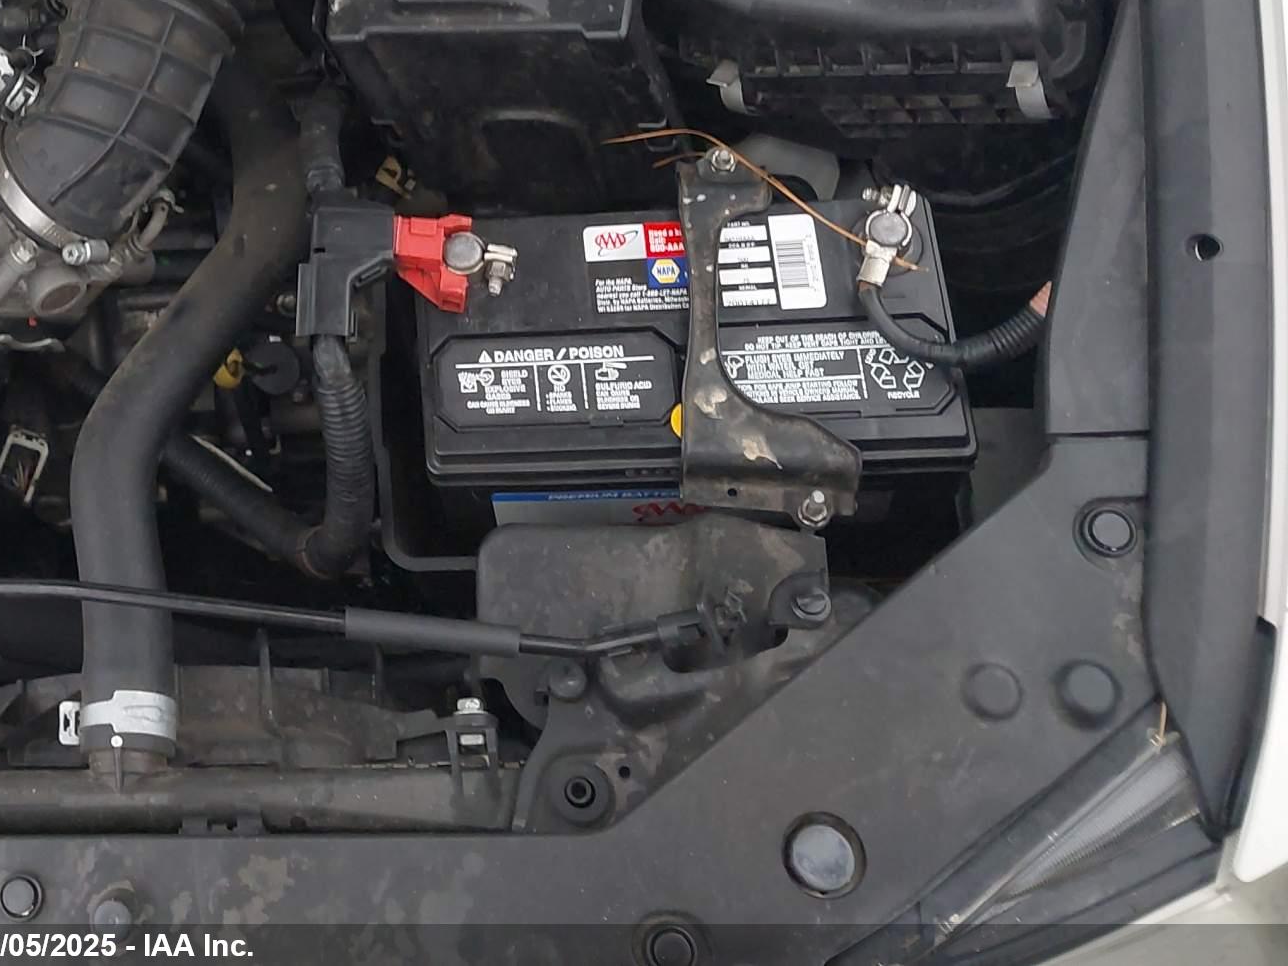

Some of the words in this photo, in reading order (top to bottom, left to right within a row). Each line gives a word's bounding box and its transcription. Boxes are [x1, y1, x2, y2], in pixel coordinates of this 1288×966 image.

[595, 232, 627, 250] AAA
[650, 242, 685, 252] 800-AAA
[657, 266, 676, 276] NAPA
[616, 277, 632, 285] NAPA
[757, 336, 774, 344] KEEP
[775, 335, 789, 343] OUT
[790, 335, 799, 343] OF
[800, 334, 814, 342] THE
[815, 333, 837, 341] REACH
[838, 332, 847, 340] OF
[744, 343, 754, 351] DO
[756, 342, 771, 350] NOT
[785, 341, 801, 349] KEEP
[803, 340, 820, 348] VENT
[840, 338, 859, 346] TIGHT
[861, 337, 874, 345] AND
[494, 348, 554, 363] DANGER
[556, 348, 566, 361] /
[569, 345, 624, 360] POISON
[745, 354, 770, 364] FLUSH
[772, 353, 792, 363] EYES
[793, 351, 844, 362] IMMEDIATELY
[746, 362, 766, 372] WITH
[798, 361, 814, 370] GET
[500, 369, 528, 378] SHIELD
[747, 369, 780, 379] MEDICAL
[782, 369, 803, 378] HELP
[804, 368, 824, 377] FAST
[501, 377, 522, 385] EYES
[595, 381, 633, 391] SULFURIC
[634, 380, 652, 389] ACID
[485, 384, 526, 394] EXPLOSIVE
[553, 384, 565, 392] NO
[754, 383, 767, 391] FOR
[767, 383, 783, 391] SAFE
[610, 389, 630, 397] CAUSE
[887, 390, 920, 399] RECYCLE
[467, 400, 479, 408] CAN
[480, 400, 498, 408] CAUSE
